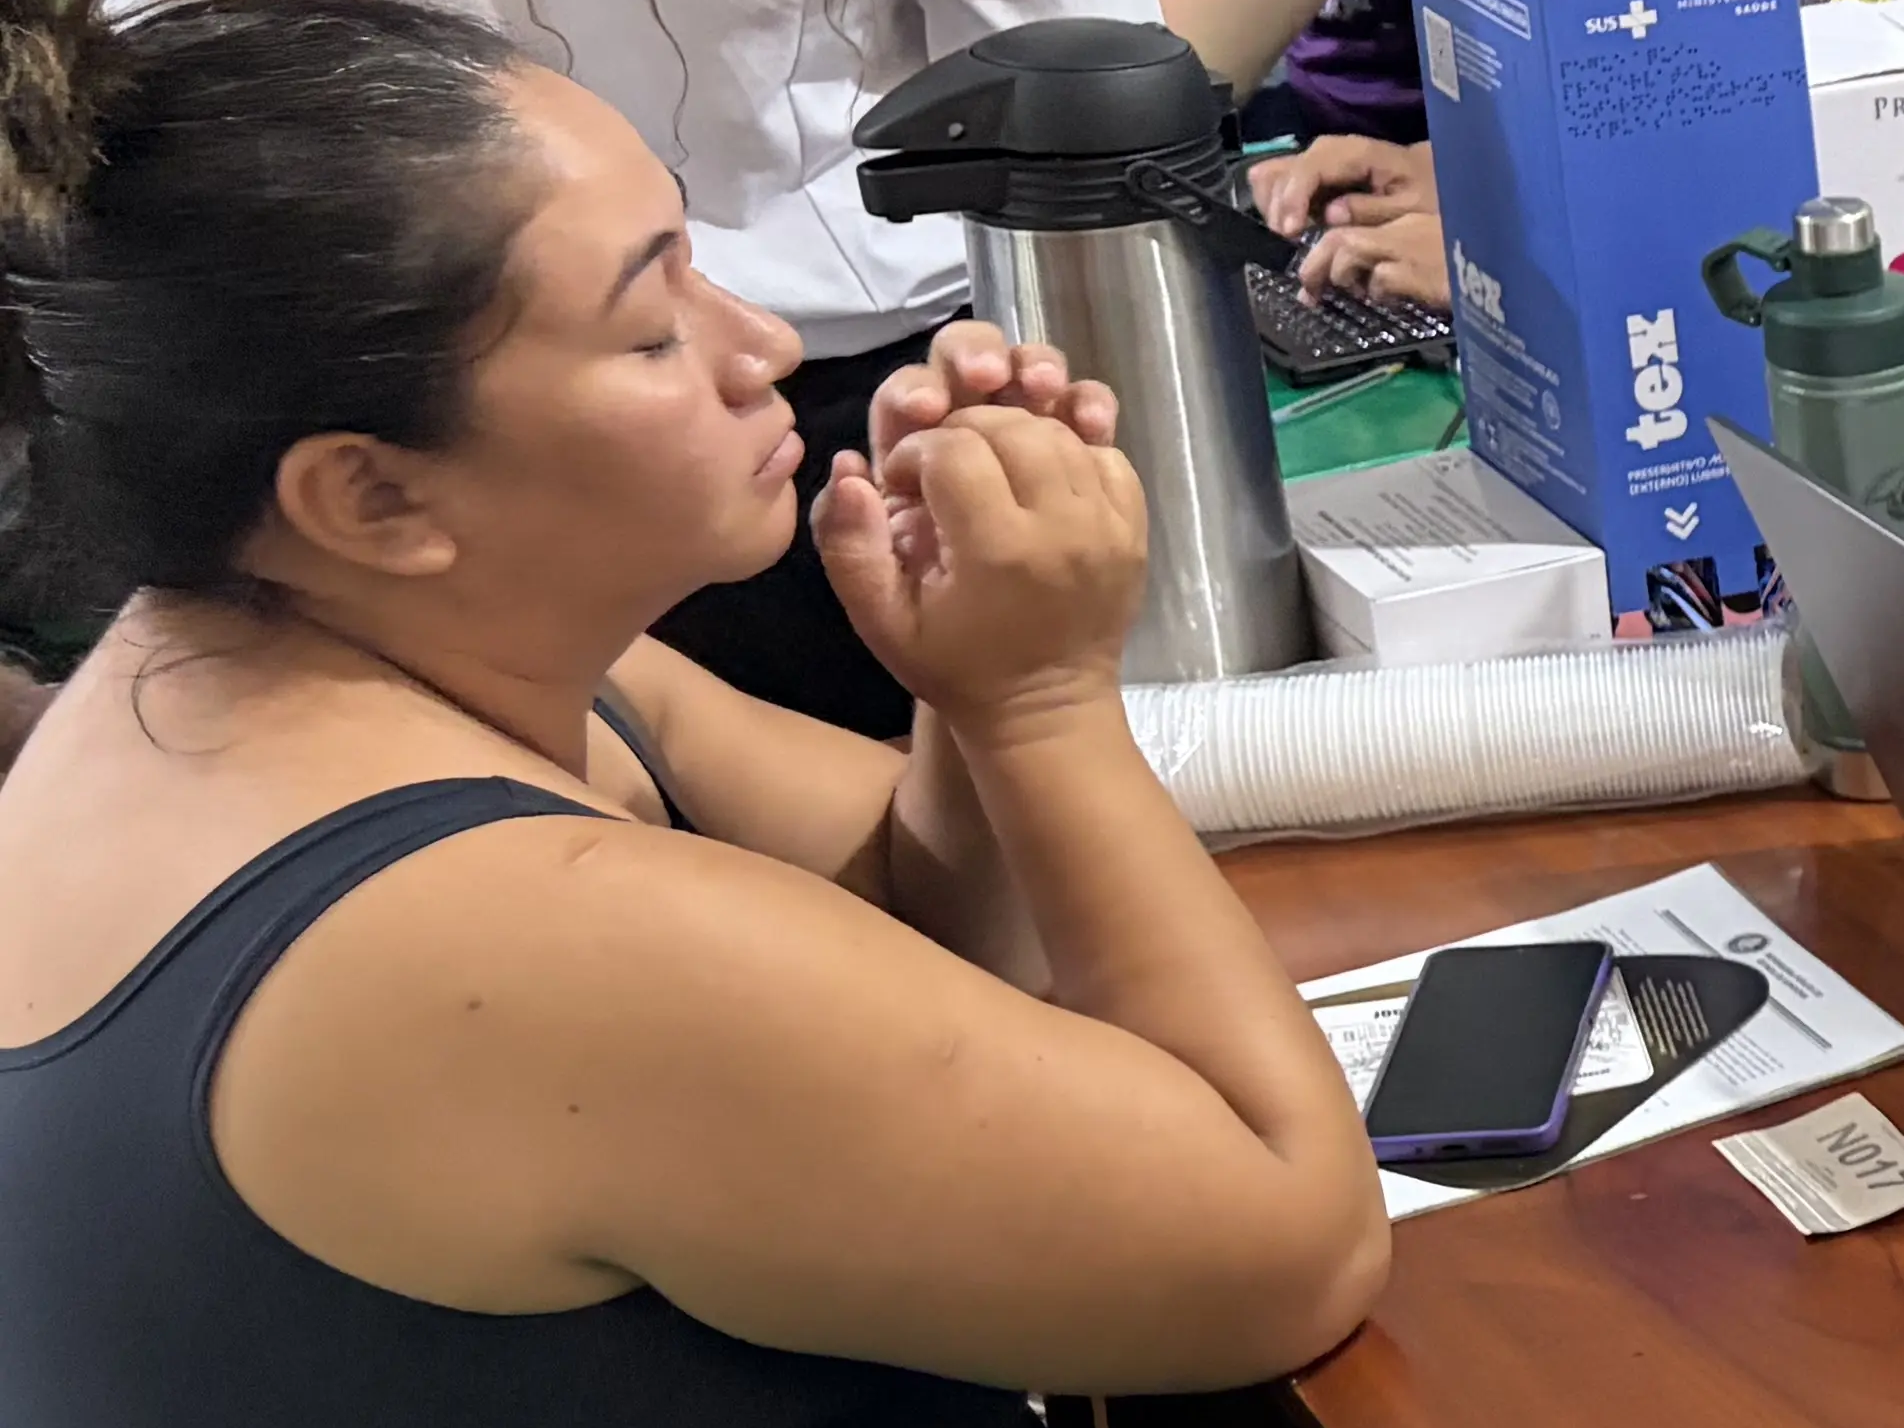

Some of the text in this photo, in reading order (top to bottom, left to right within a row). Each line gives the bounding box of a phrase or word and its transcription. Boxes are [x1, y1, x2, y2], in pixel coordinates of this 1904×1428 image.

[1735, 0, 1778, 16] SAÚDE
[1585, 16, 1618, 35] SUS
[1626, 308, 1688, 451] tex
